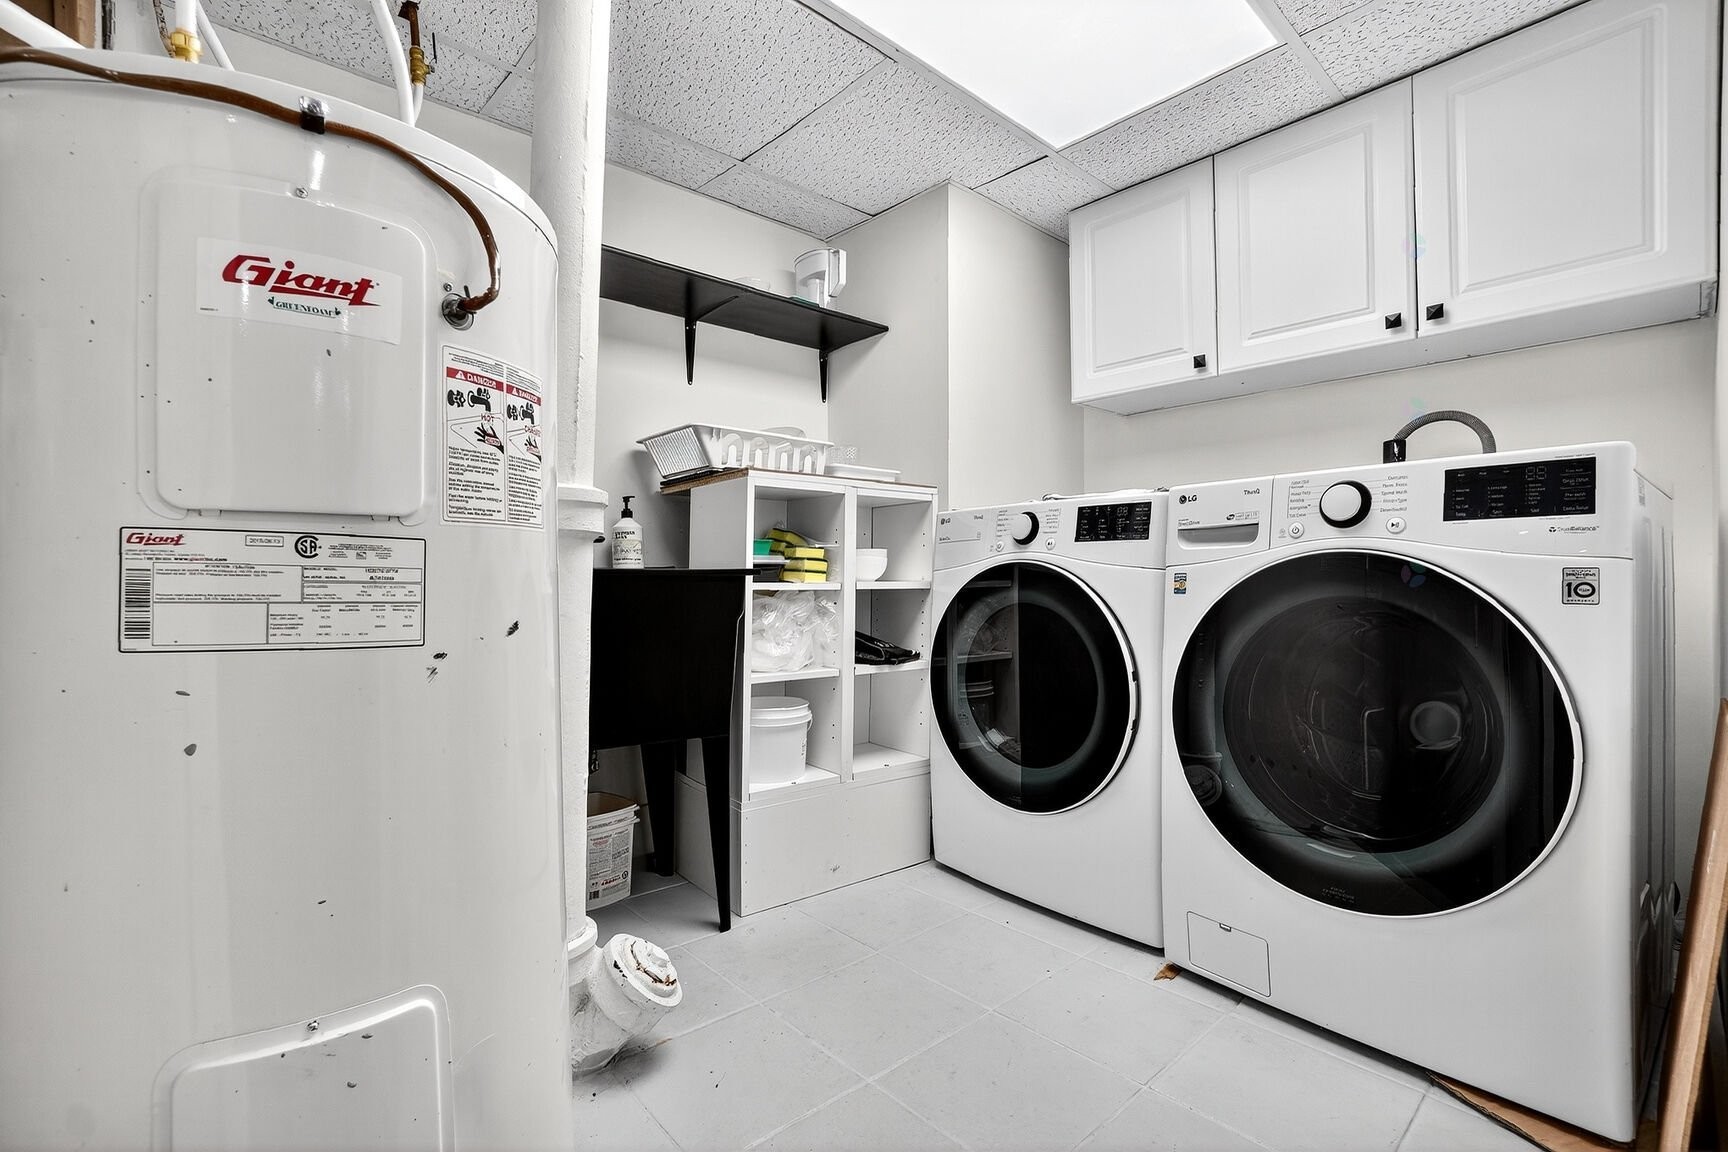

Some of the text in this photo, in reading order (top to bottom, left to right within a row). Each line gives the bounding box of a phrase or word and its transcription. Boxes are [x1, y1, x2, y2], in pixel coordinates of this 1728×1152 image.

[222, 254, 380, 306] Giant
[1187, 494, 1198, 502] LG
[126, 532, 186, 546] Giant
[1566, 581, 1596, 598] 10
